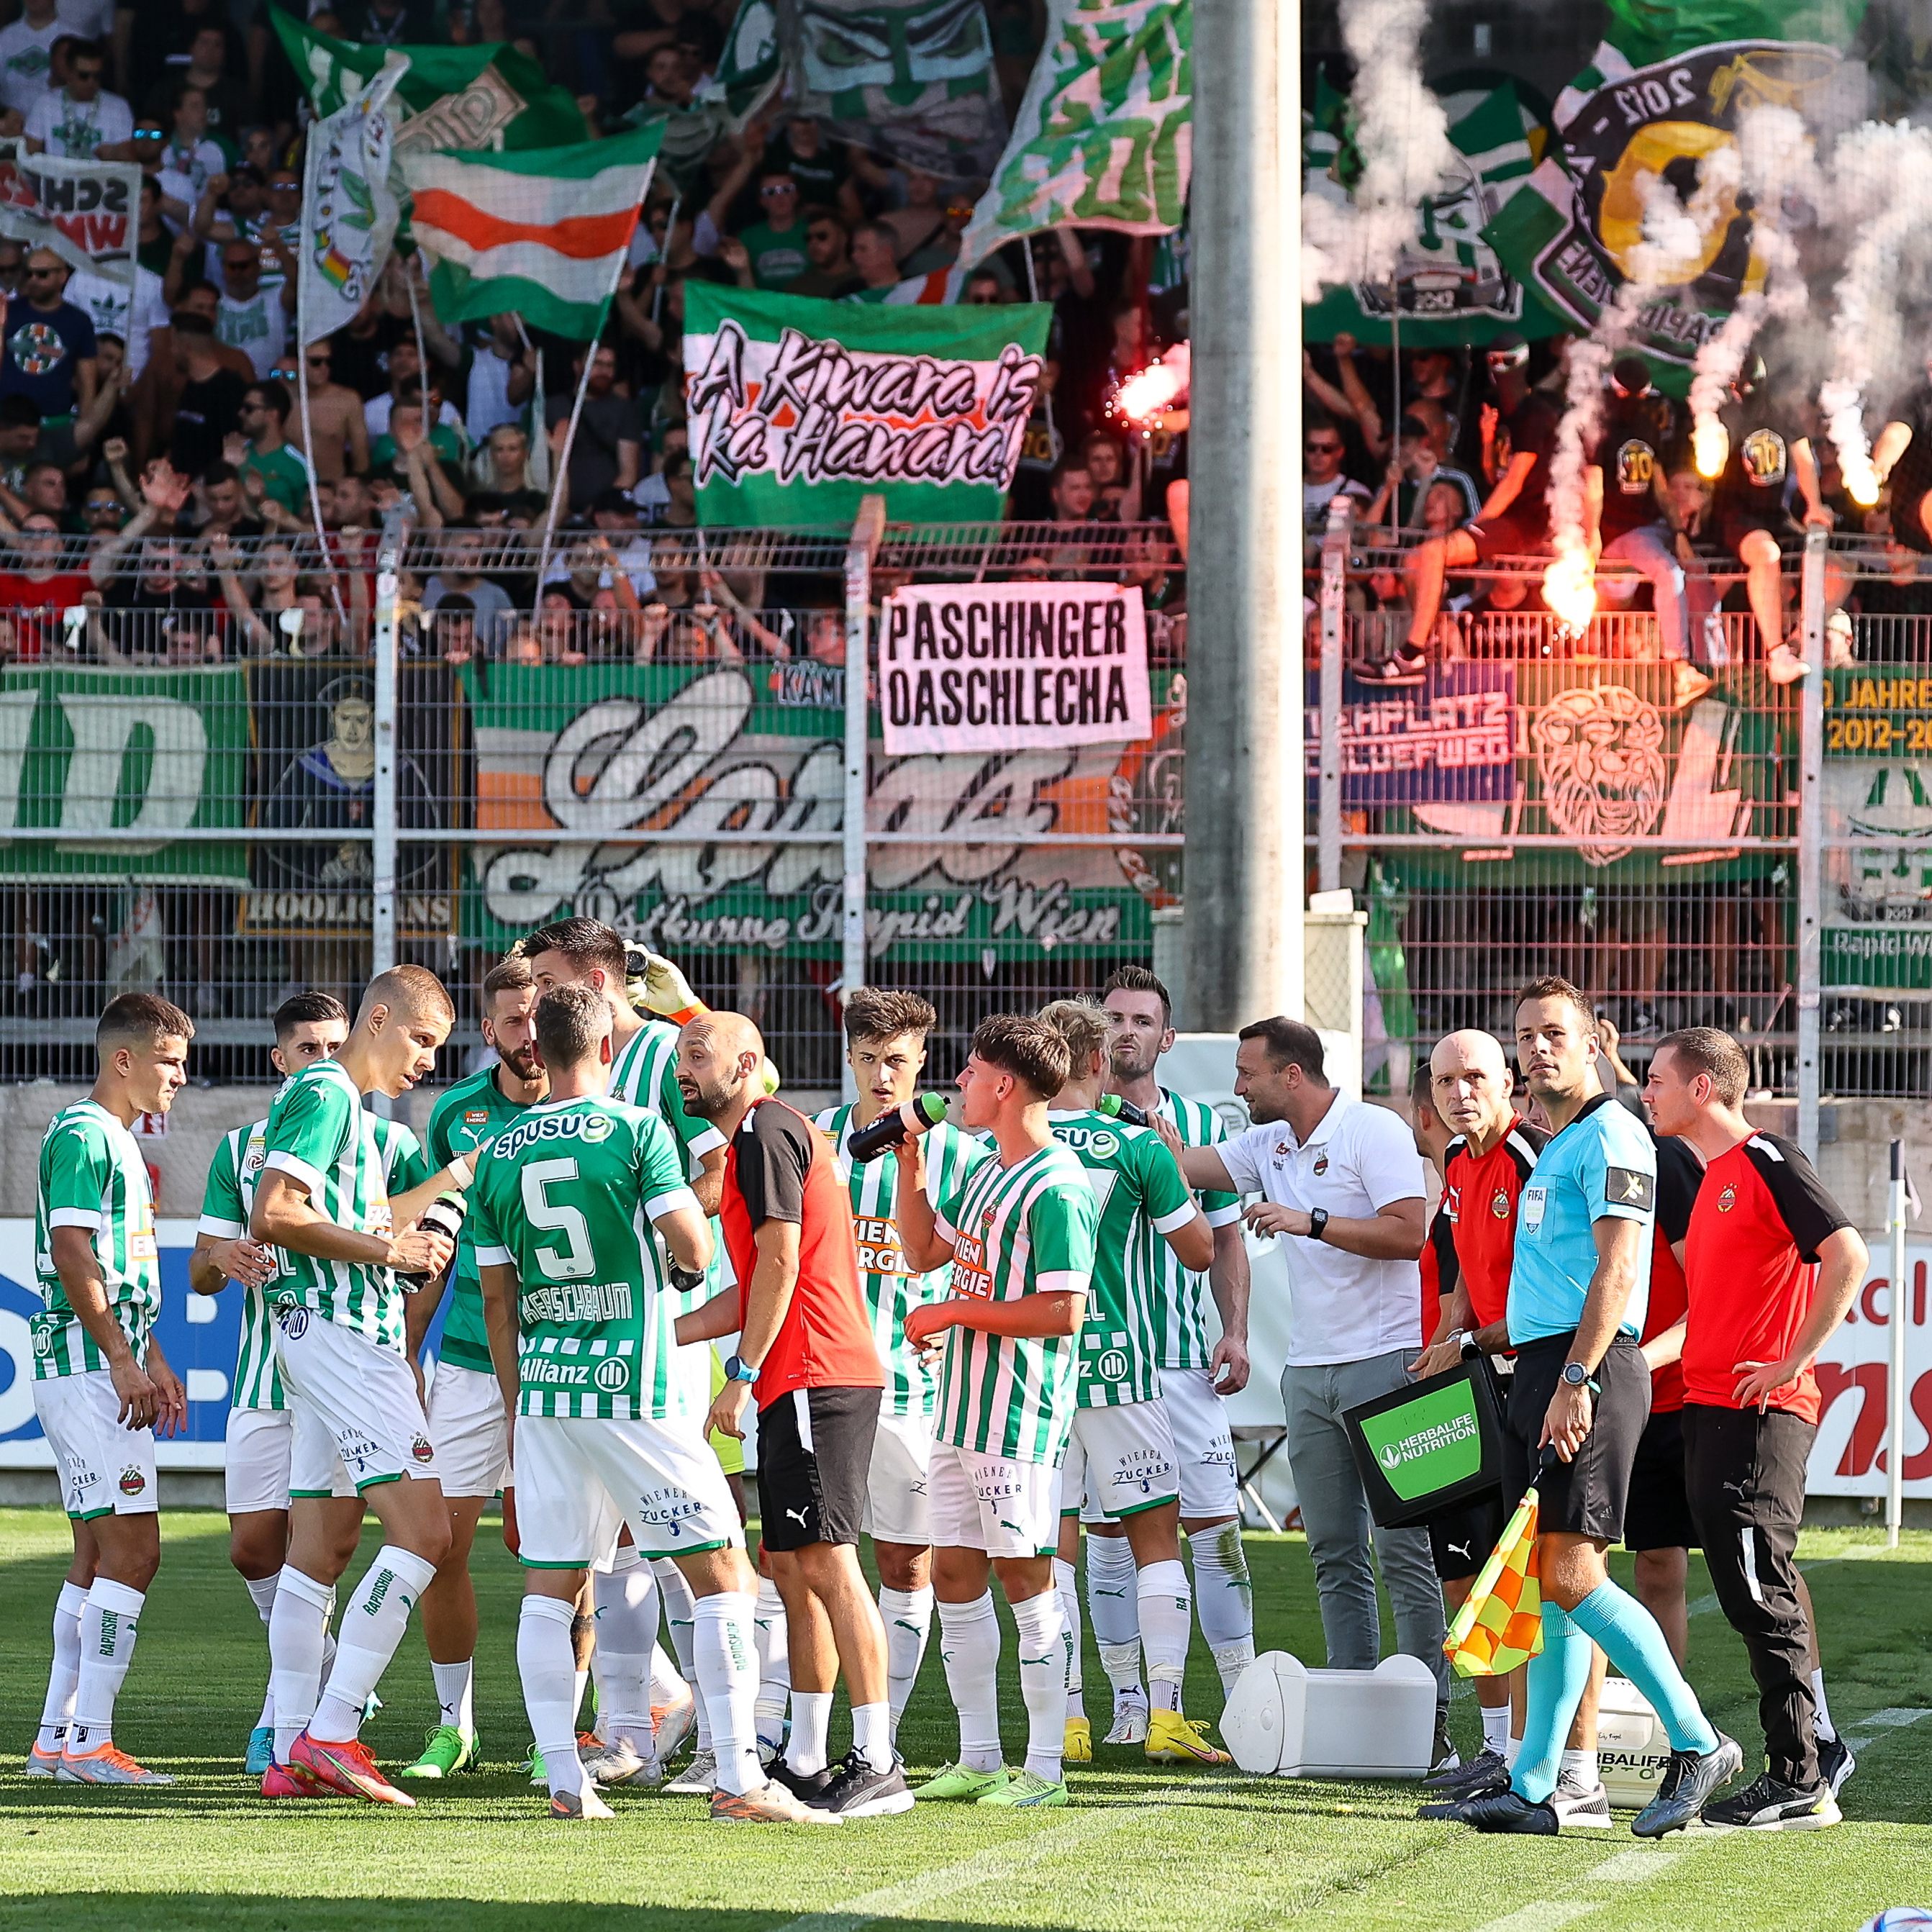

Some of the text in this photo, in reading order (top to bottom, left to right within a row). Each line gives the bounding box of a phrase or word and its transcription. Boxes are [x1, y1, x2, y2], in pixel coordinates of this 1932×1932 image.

[692, 321, 1043, 422] A Kiwara is
[697, 391, 768, 485] ka
[888, 599, 1128, 661] PASCHINGER
[889, 666, 1130, 726] OASCHLECHA
[1844, 679, 1932, 709] JAHRE
[984, 876, 1120, 941] Wien
[495, 1116, 581, 1158] spusu
[1527, 1189, 1543, 1201] FIFA
[521, 1156, 597, 1280] 5
[522, 1282, 632, 1325] KERSCHBAUM
[520, 1358, 590, 1384] Allianz
[1399, 1412, 1474, 1452] HERBALIFE
[1402, 1424, 1477, 1463] NUTRITION
[639, 1502, 702, 1523] ZUCKER
[640, 1487, 687, 1506] WIENER
